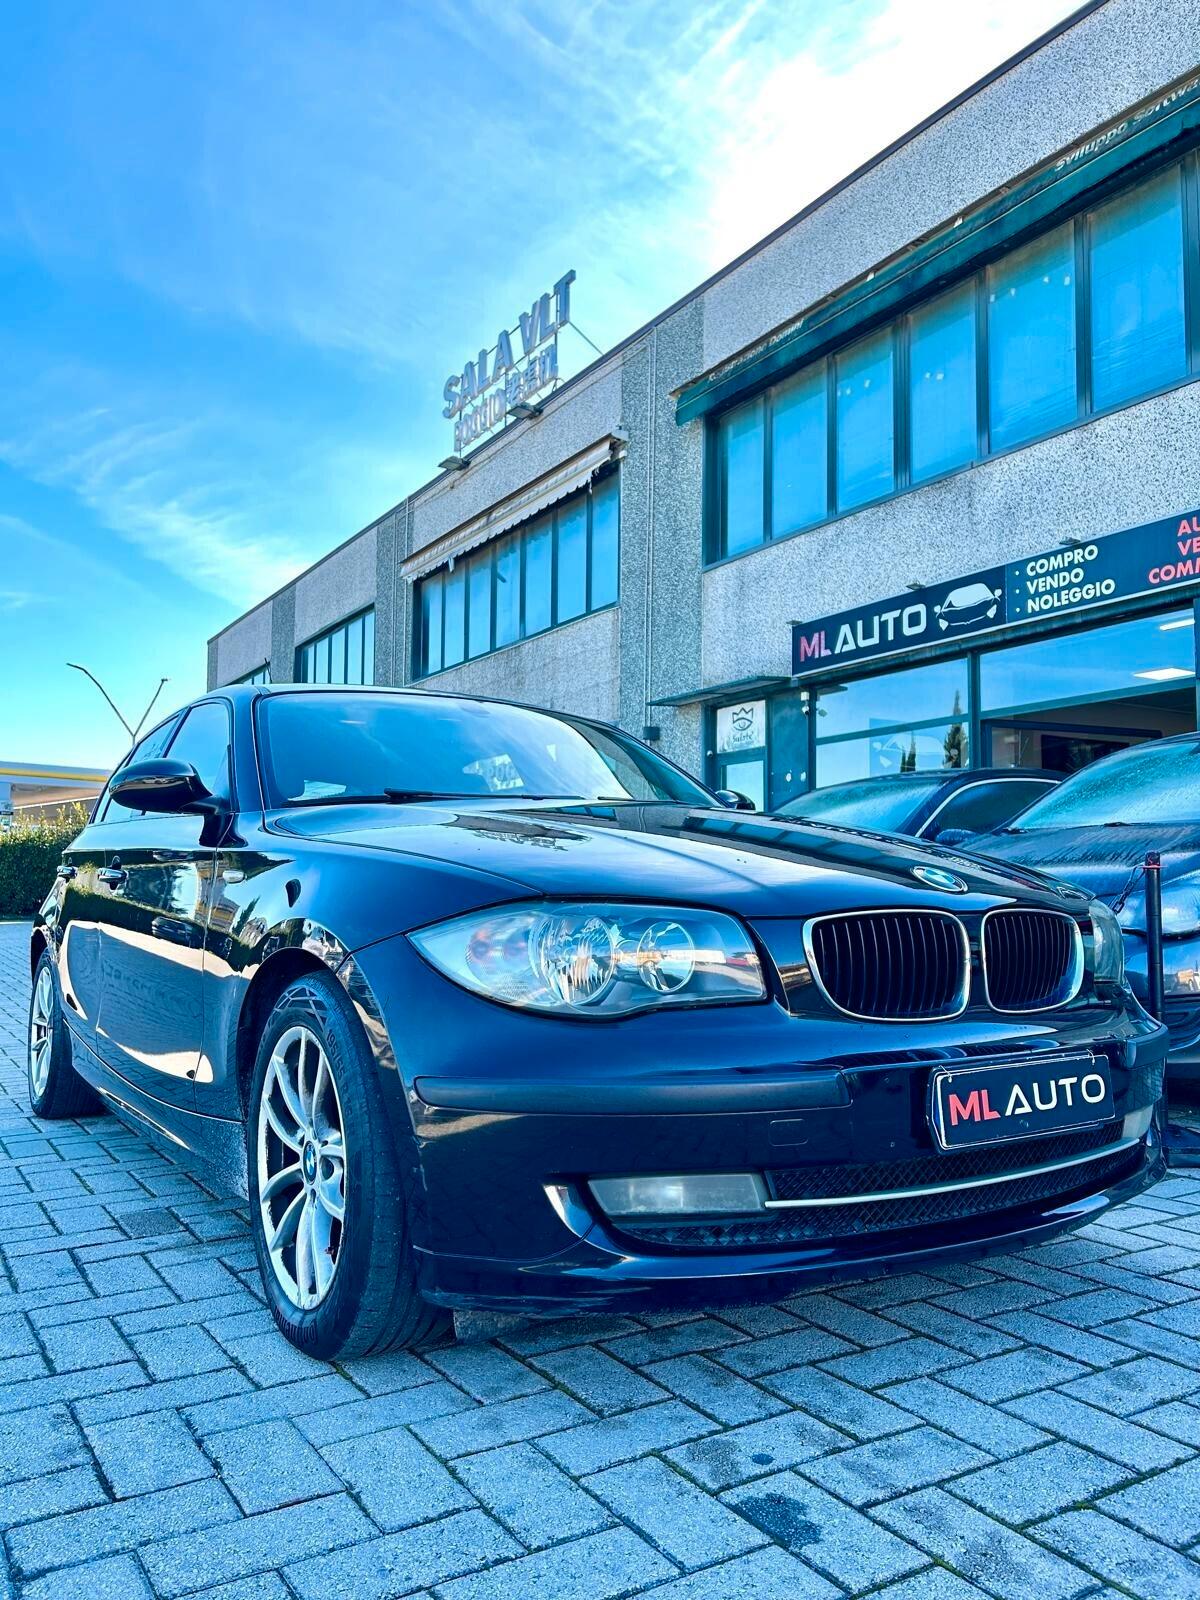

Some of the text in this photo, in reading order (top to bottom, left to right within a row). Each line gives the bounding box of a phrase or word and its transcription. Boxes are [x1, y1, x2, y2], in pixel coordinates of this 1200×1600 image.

[1055, 122, 1128, 172] Sviluppo
[443, 330, 515, 419] SALA
[519, 269, 576, 355] VLT
[1026, 544, 1099, 577] COMPRO
[1177, 537, 1200, 556] VE
[1026, 567, 1085, 595] VENDO
[1027, 578, 1116, 614] NOLEGGIO
[799, 603, 927, 662] ML AUTO
[948, 1073, 1106, 1126] ML AUTO
